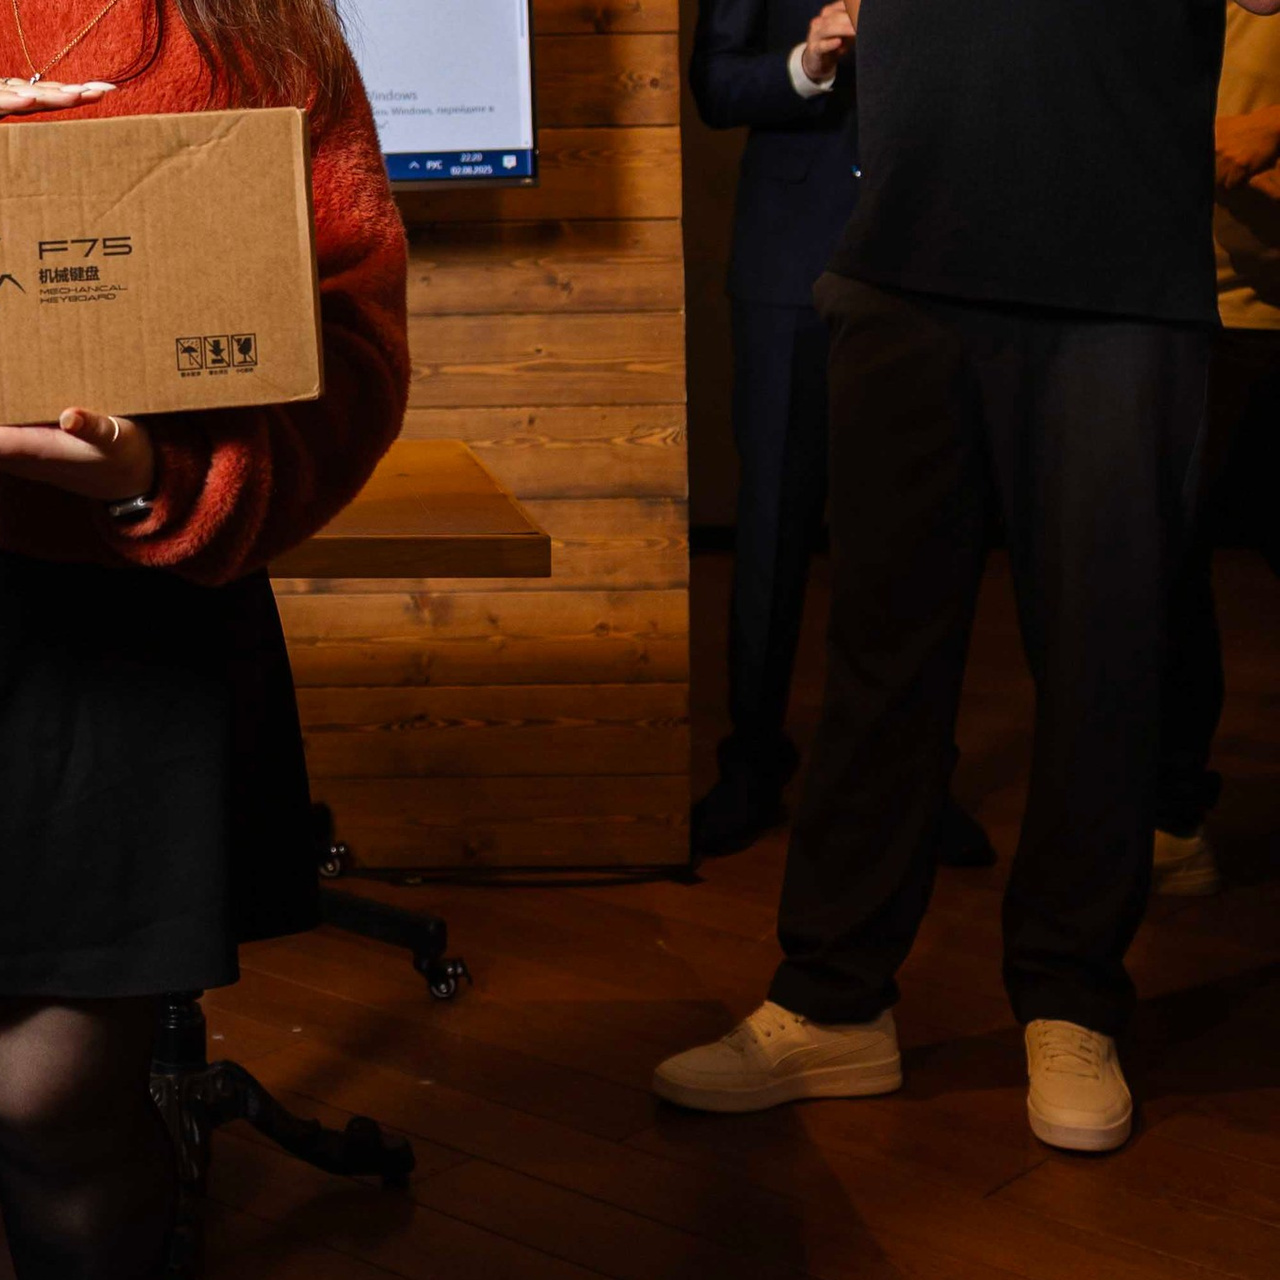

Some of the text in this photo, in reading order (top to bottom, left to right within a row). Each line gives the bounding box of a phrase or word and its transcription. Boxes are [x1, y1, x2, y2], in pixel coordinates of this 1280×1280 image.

[38, 237, 132, 260] F75
[38, 266, 100, 284] 机械键盘
[39, 284, 128, 296] MECHANICAL
[39, 293, 116, 304] KEYBOARD
